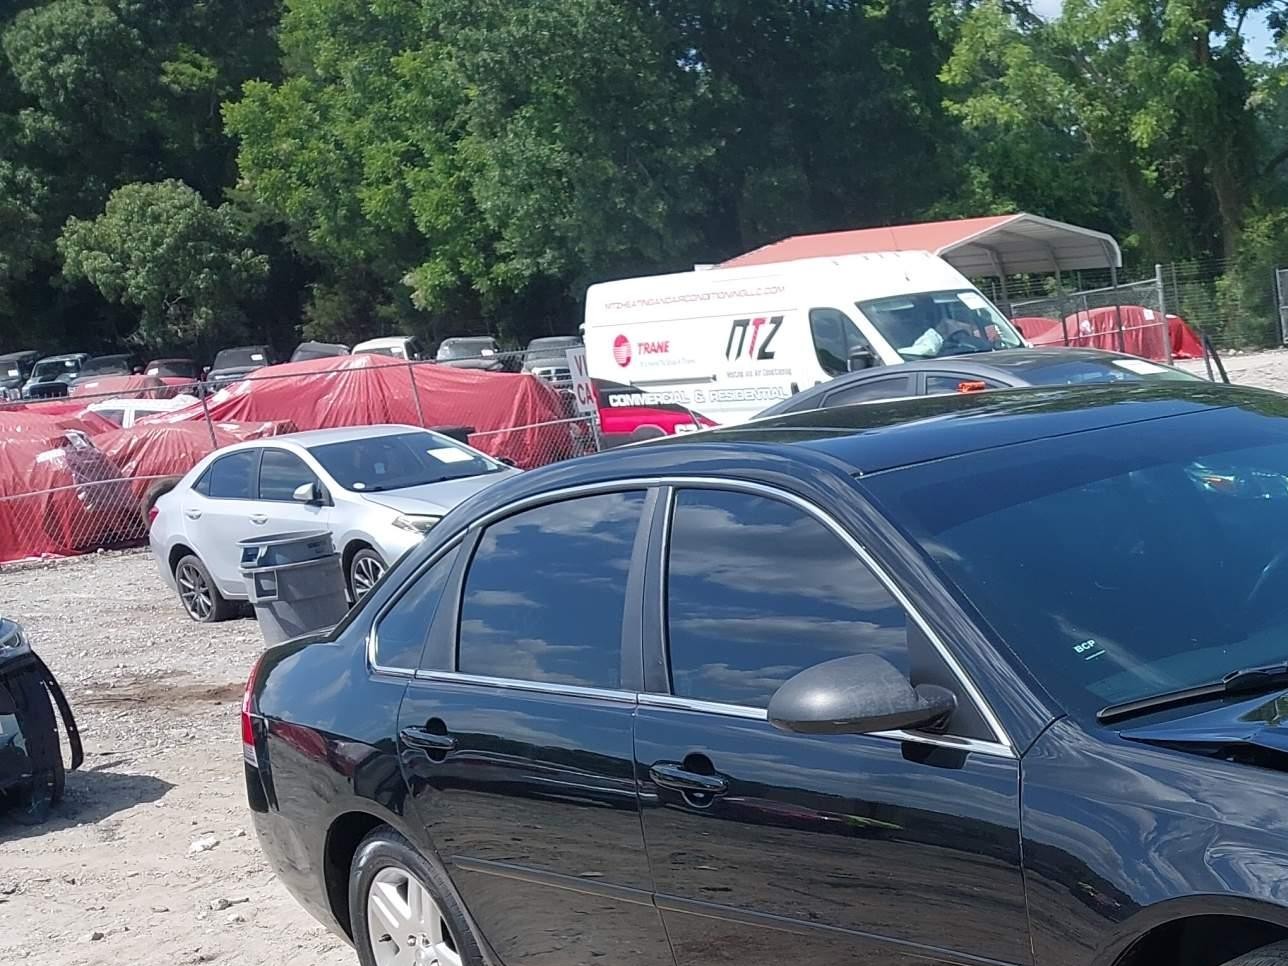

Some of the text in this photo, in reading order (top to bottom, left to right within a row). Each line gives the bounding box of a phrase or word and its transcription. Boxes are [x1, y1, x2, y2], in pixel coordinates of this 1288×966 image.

[637, 341, 670, 356] TRANE
[608, 385, 789, 407] COMMERCIAL & RESIDENTIAL
[1074, 639, 1095, 653] BCP
